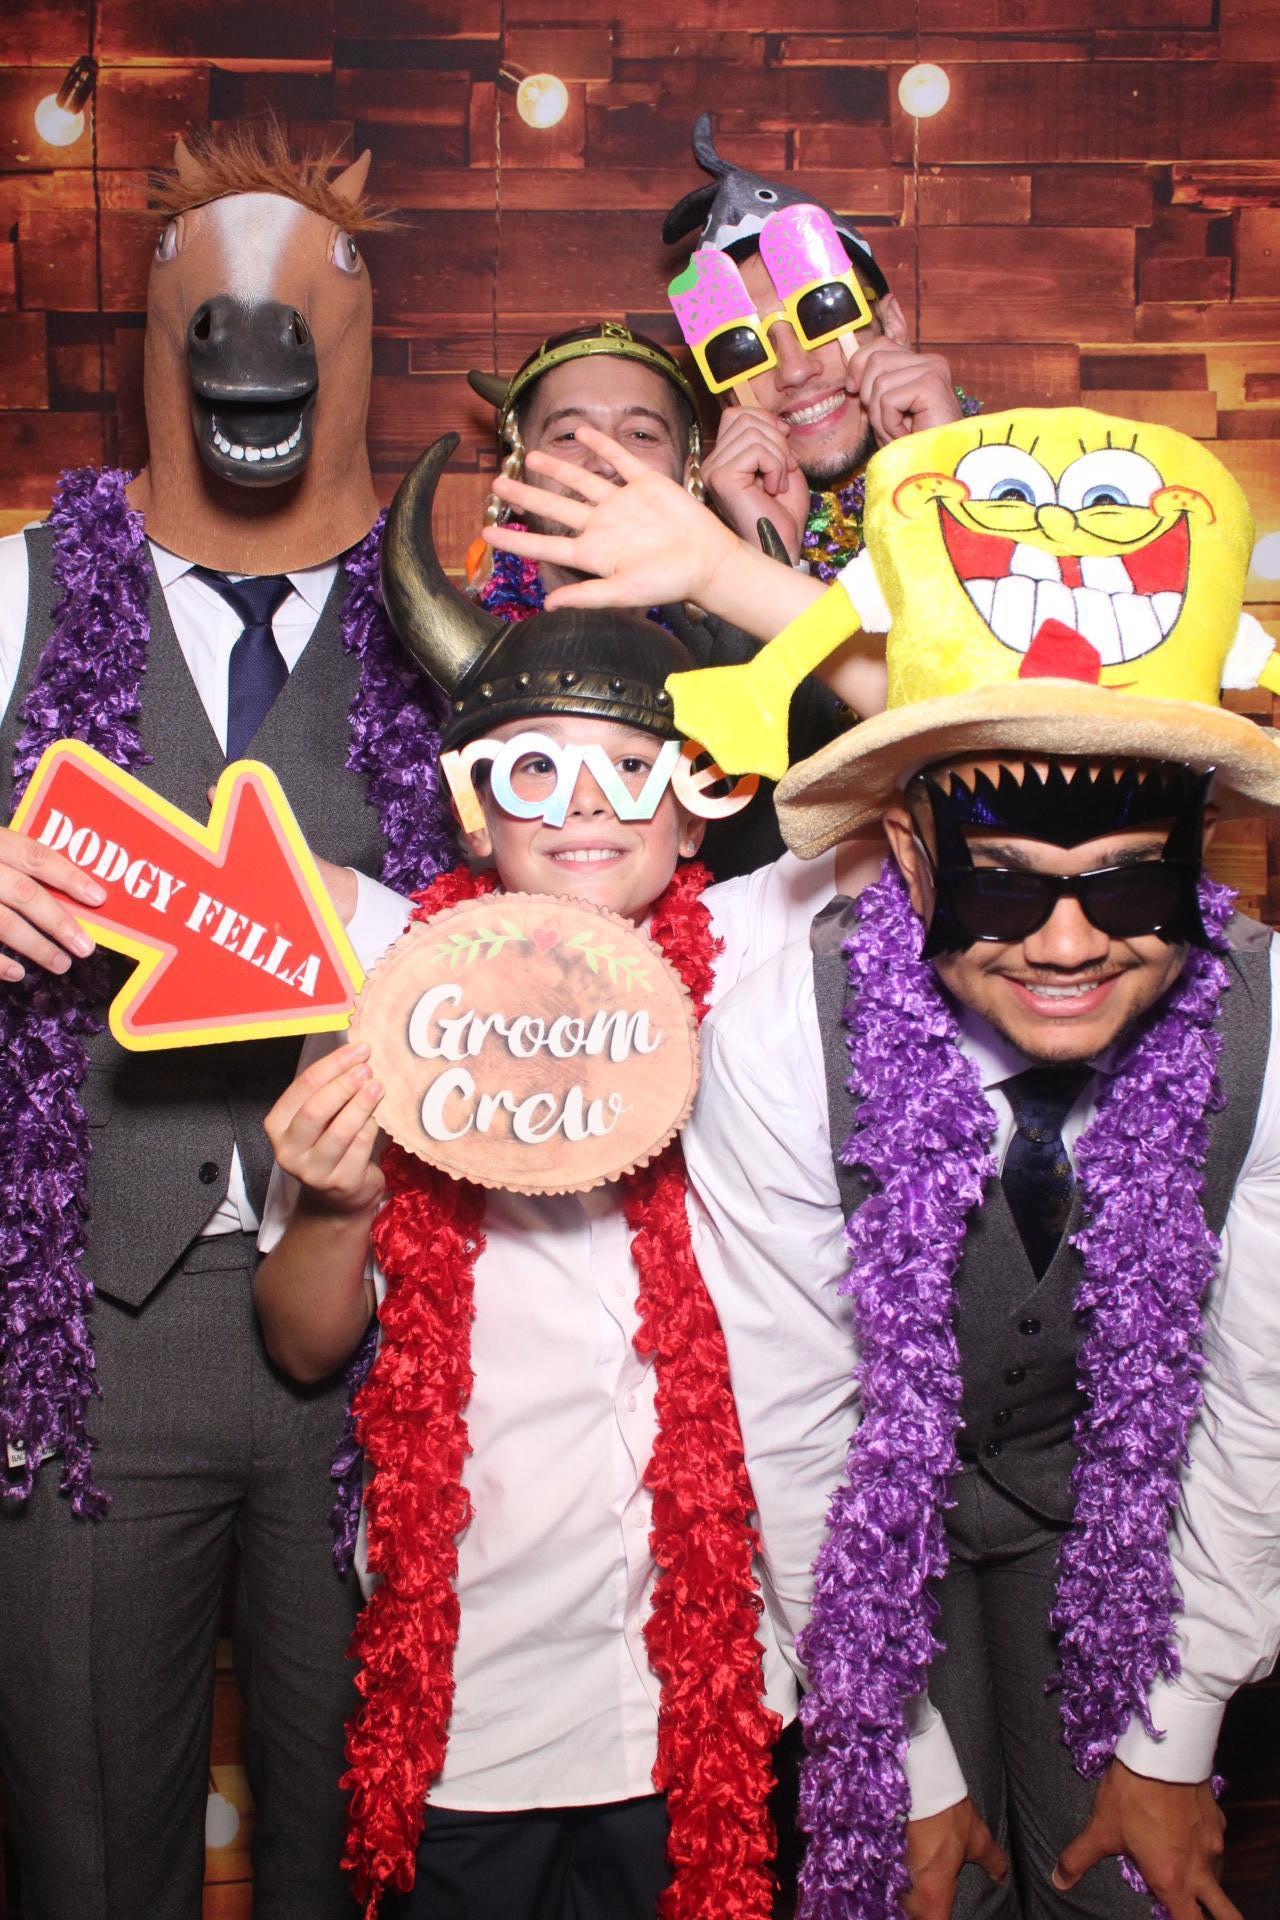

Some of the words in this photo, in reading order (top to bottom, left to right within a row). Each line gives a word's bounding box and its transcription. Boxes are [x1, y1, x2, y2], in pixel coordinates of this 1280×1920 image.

[440, 732, 760, 833] rave
[37, 808, 187, 913] DODGY
[184, 891, 321, 998] FELLA
[408, 983, 662, 1063] Groom
[421, 1067, 633, 1144] Crew
